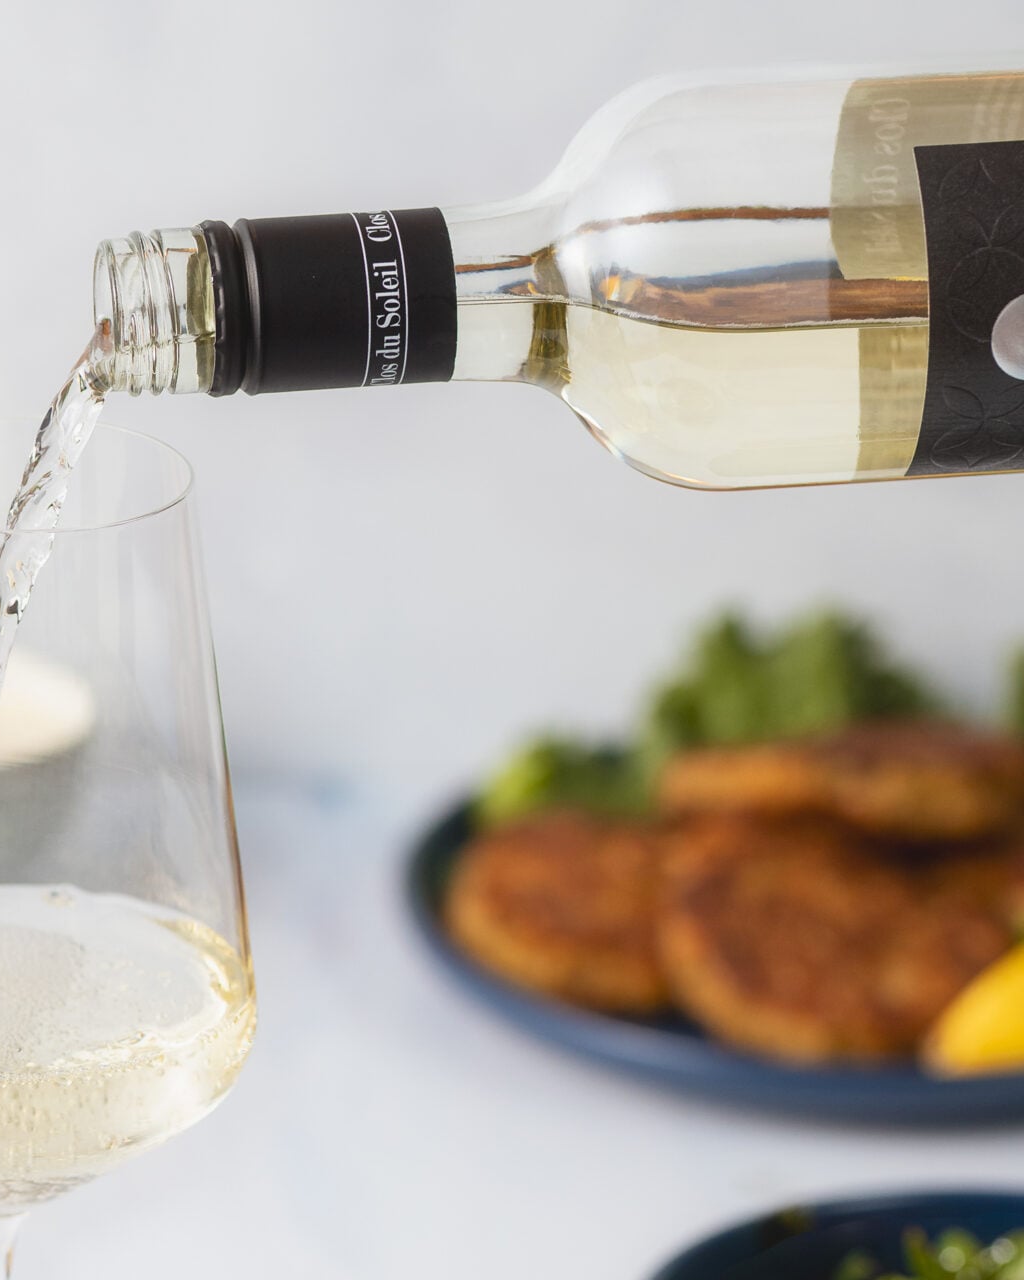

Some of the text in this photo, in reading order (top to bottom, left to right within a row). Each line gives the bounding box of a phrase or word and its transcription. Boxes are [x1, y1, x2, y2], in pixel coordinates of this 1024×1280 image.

[365, 213, 393, 242] Clos
[372, 259, 401, 328] Soleil
[376, 333, 401, 359] du
